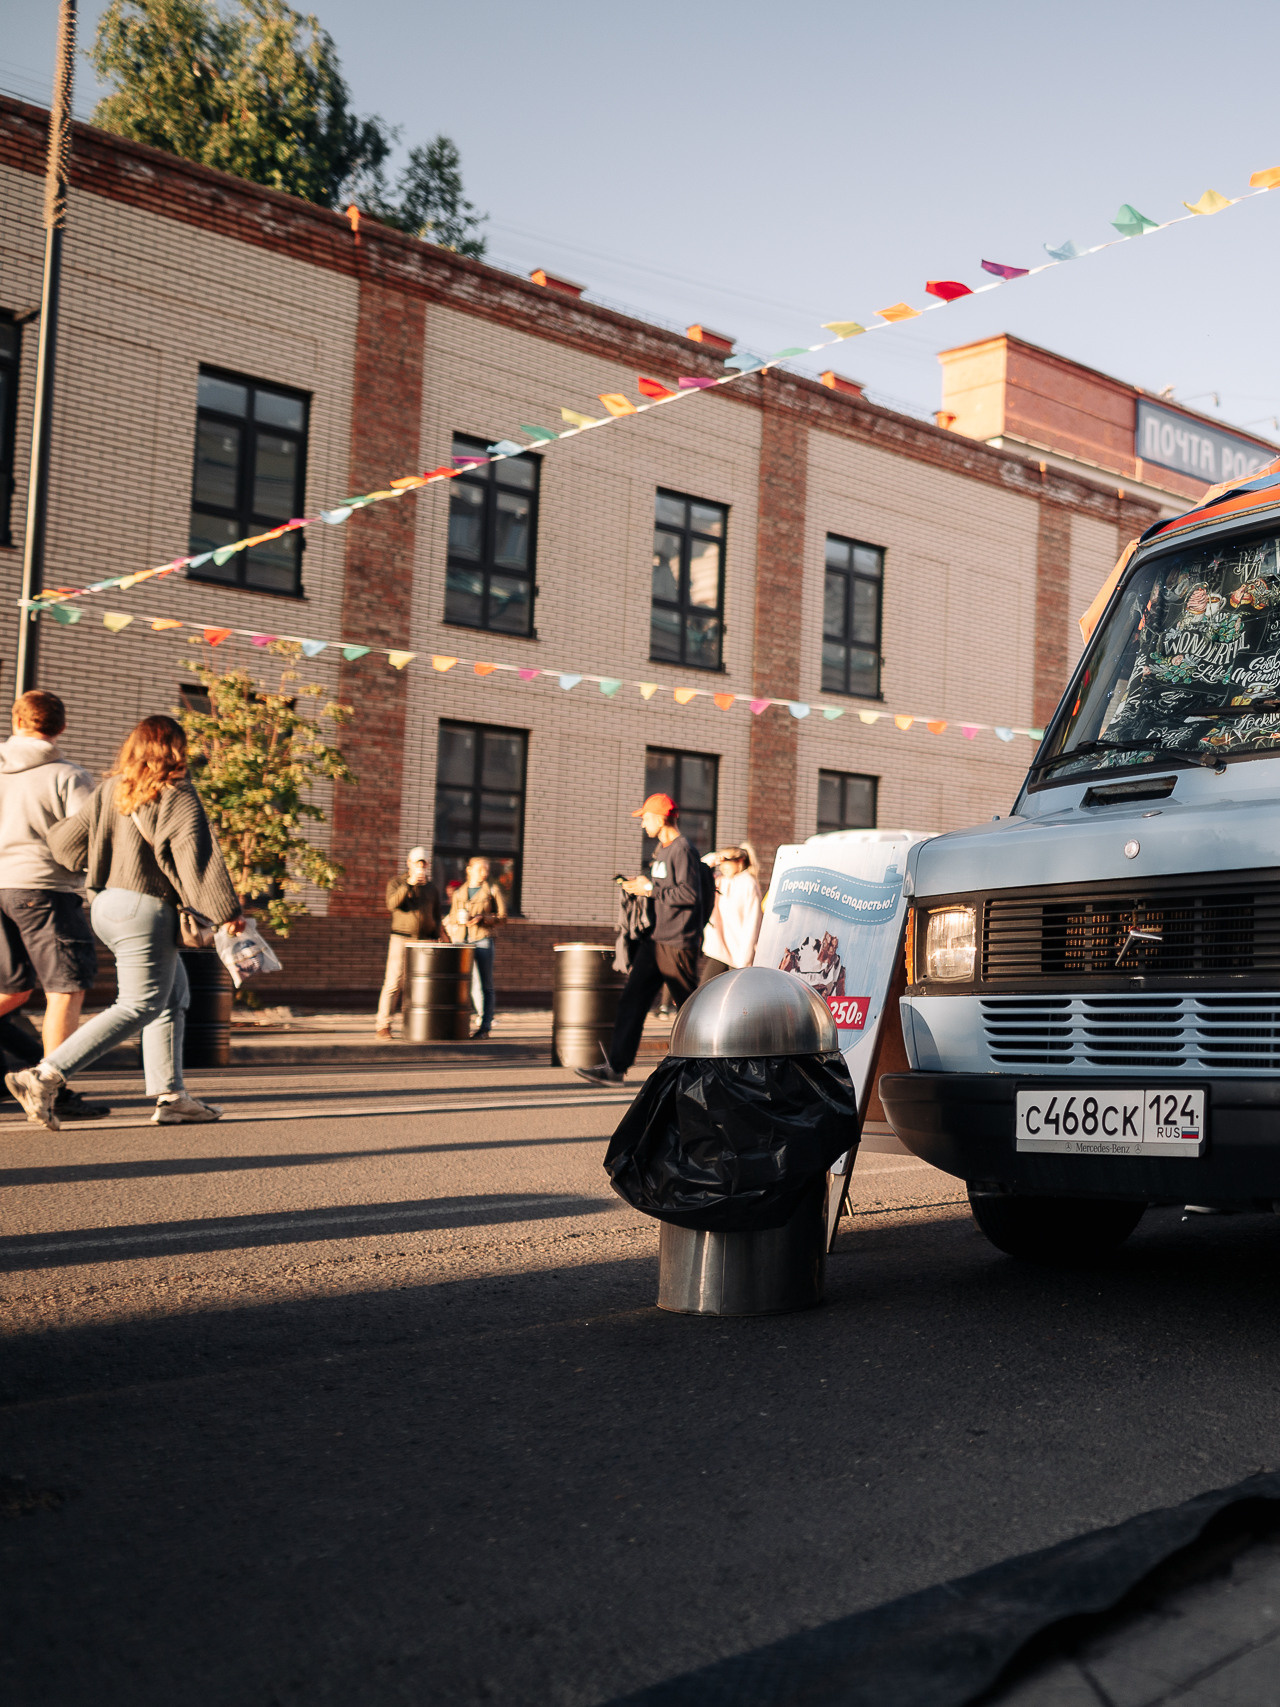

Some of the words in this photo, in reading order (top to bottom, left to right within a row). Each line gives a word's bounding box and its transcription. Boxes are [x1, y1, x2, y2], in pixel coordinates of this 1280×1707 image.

[1144, 416, 1216, 475] ПОЧТА
[1249, 648, 1280, 674] Good
[781, 878, 821, 896] Порадуй
[820, 885, 841, 901] себя
[841, 893, 896, 912] сладостью!
[1025, 1096, 1139, 1137] С468СК
[1149, 1094, 1195, 1126] 124
[1075, 1142, 1130, 1154] Mercedes-Benz
[1156, 1127, 1181, 1139] RUS
